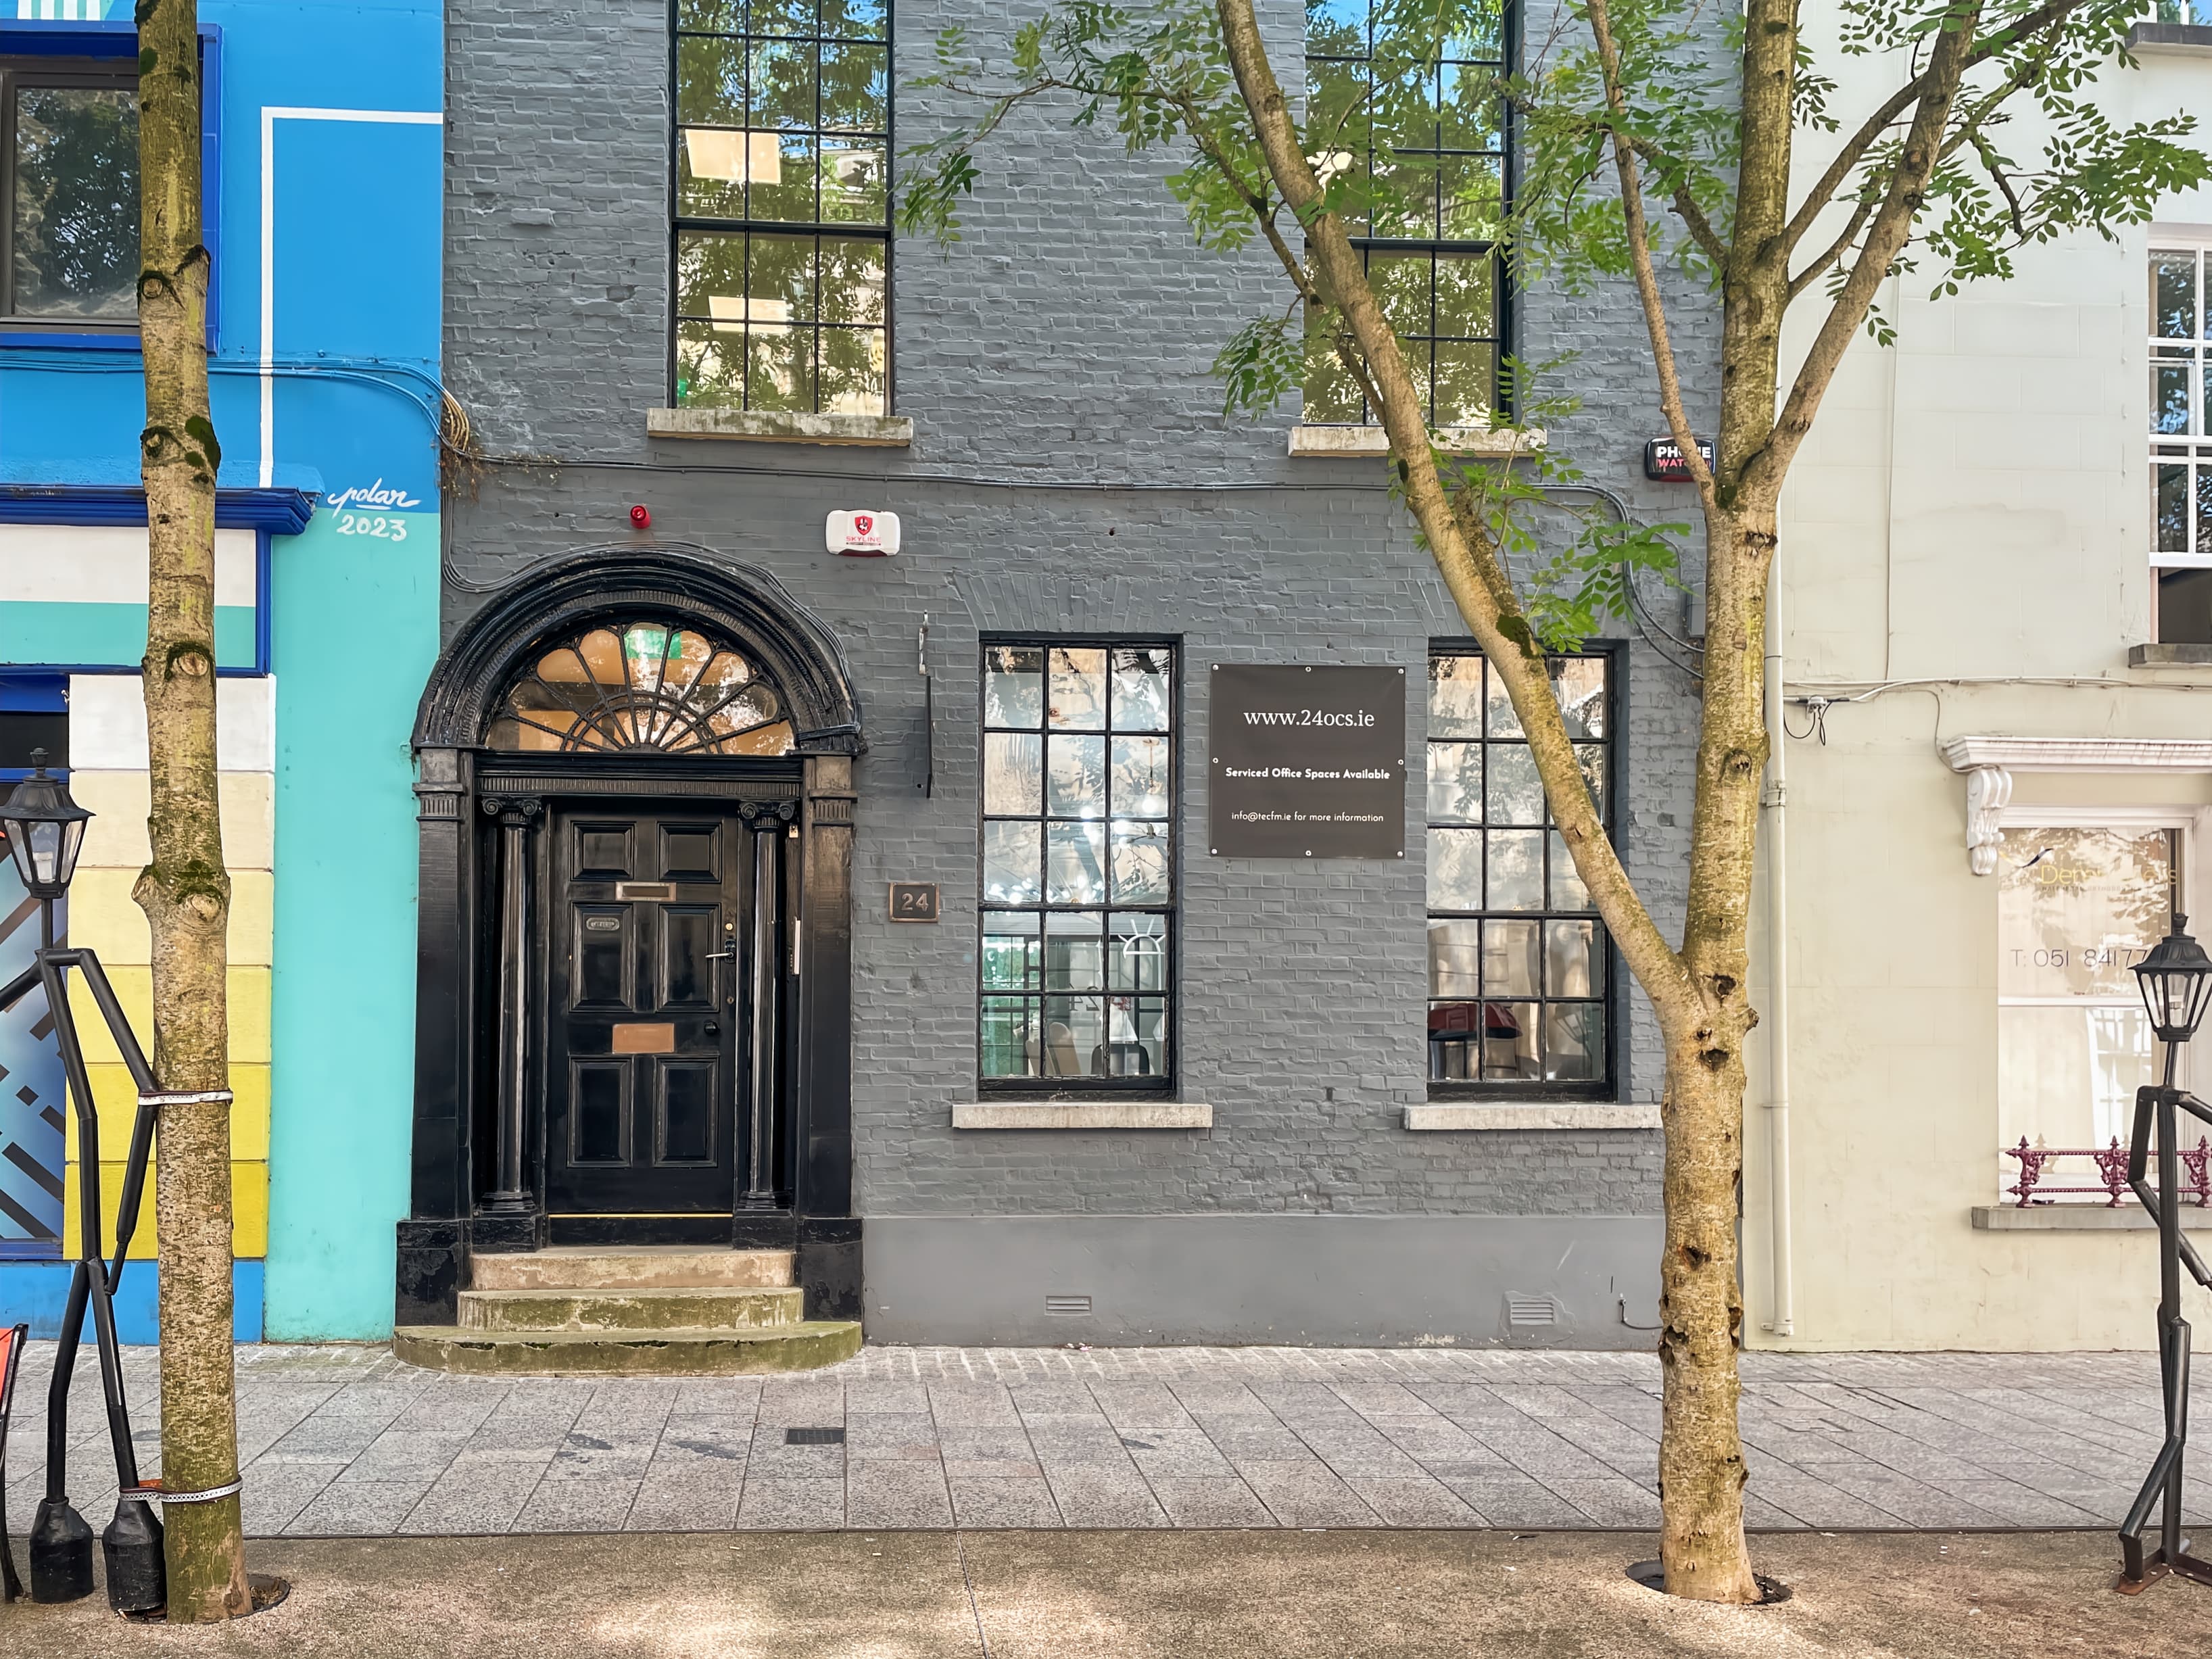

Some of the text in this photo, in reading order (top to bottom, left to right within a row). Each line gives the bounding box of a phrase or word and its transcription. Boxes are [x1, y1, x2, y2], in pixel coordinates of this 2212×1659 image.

[1657, 446, 1711, 458] PHE
[337, 514, 407, 542] 2023
[1243, 709, 1375, 727] www.24ocs.ie
[1226, 767, 1391, 780] Serviced Office Spaces Available
[1231, 811, 1291, 822] info@tecfm.ie
[1294, 811, 1306, 821] for
[1334, 811, 1385, 822] information
[901, 892, 930, 912] 24
[2010, 949, 2027, 967] T:
[2034, 948, 2069, 967] 051
